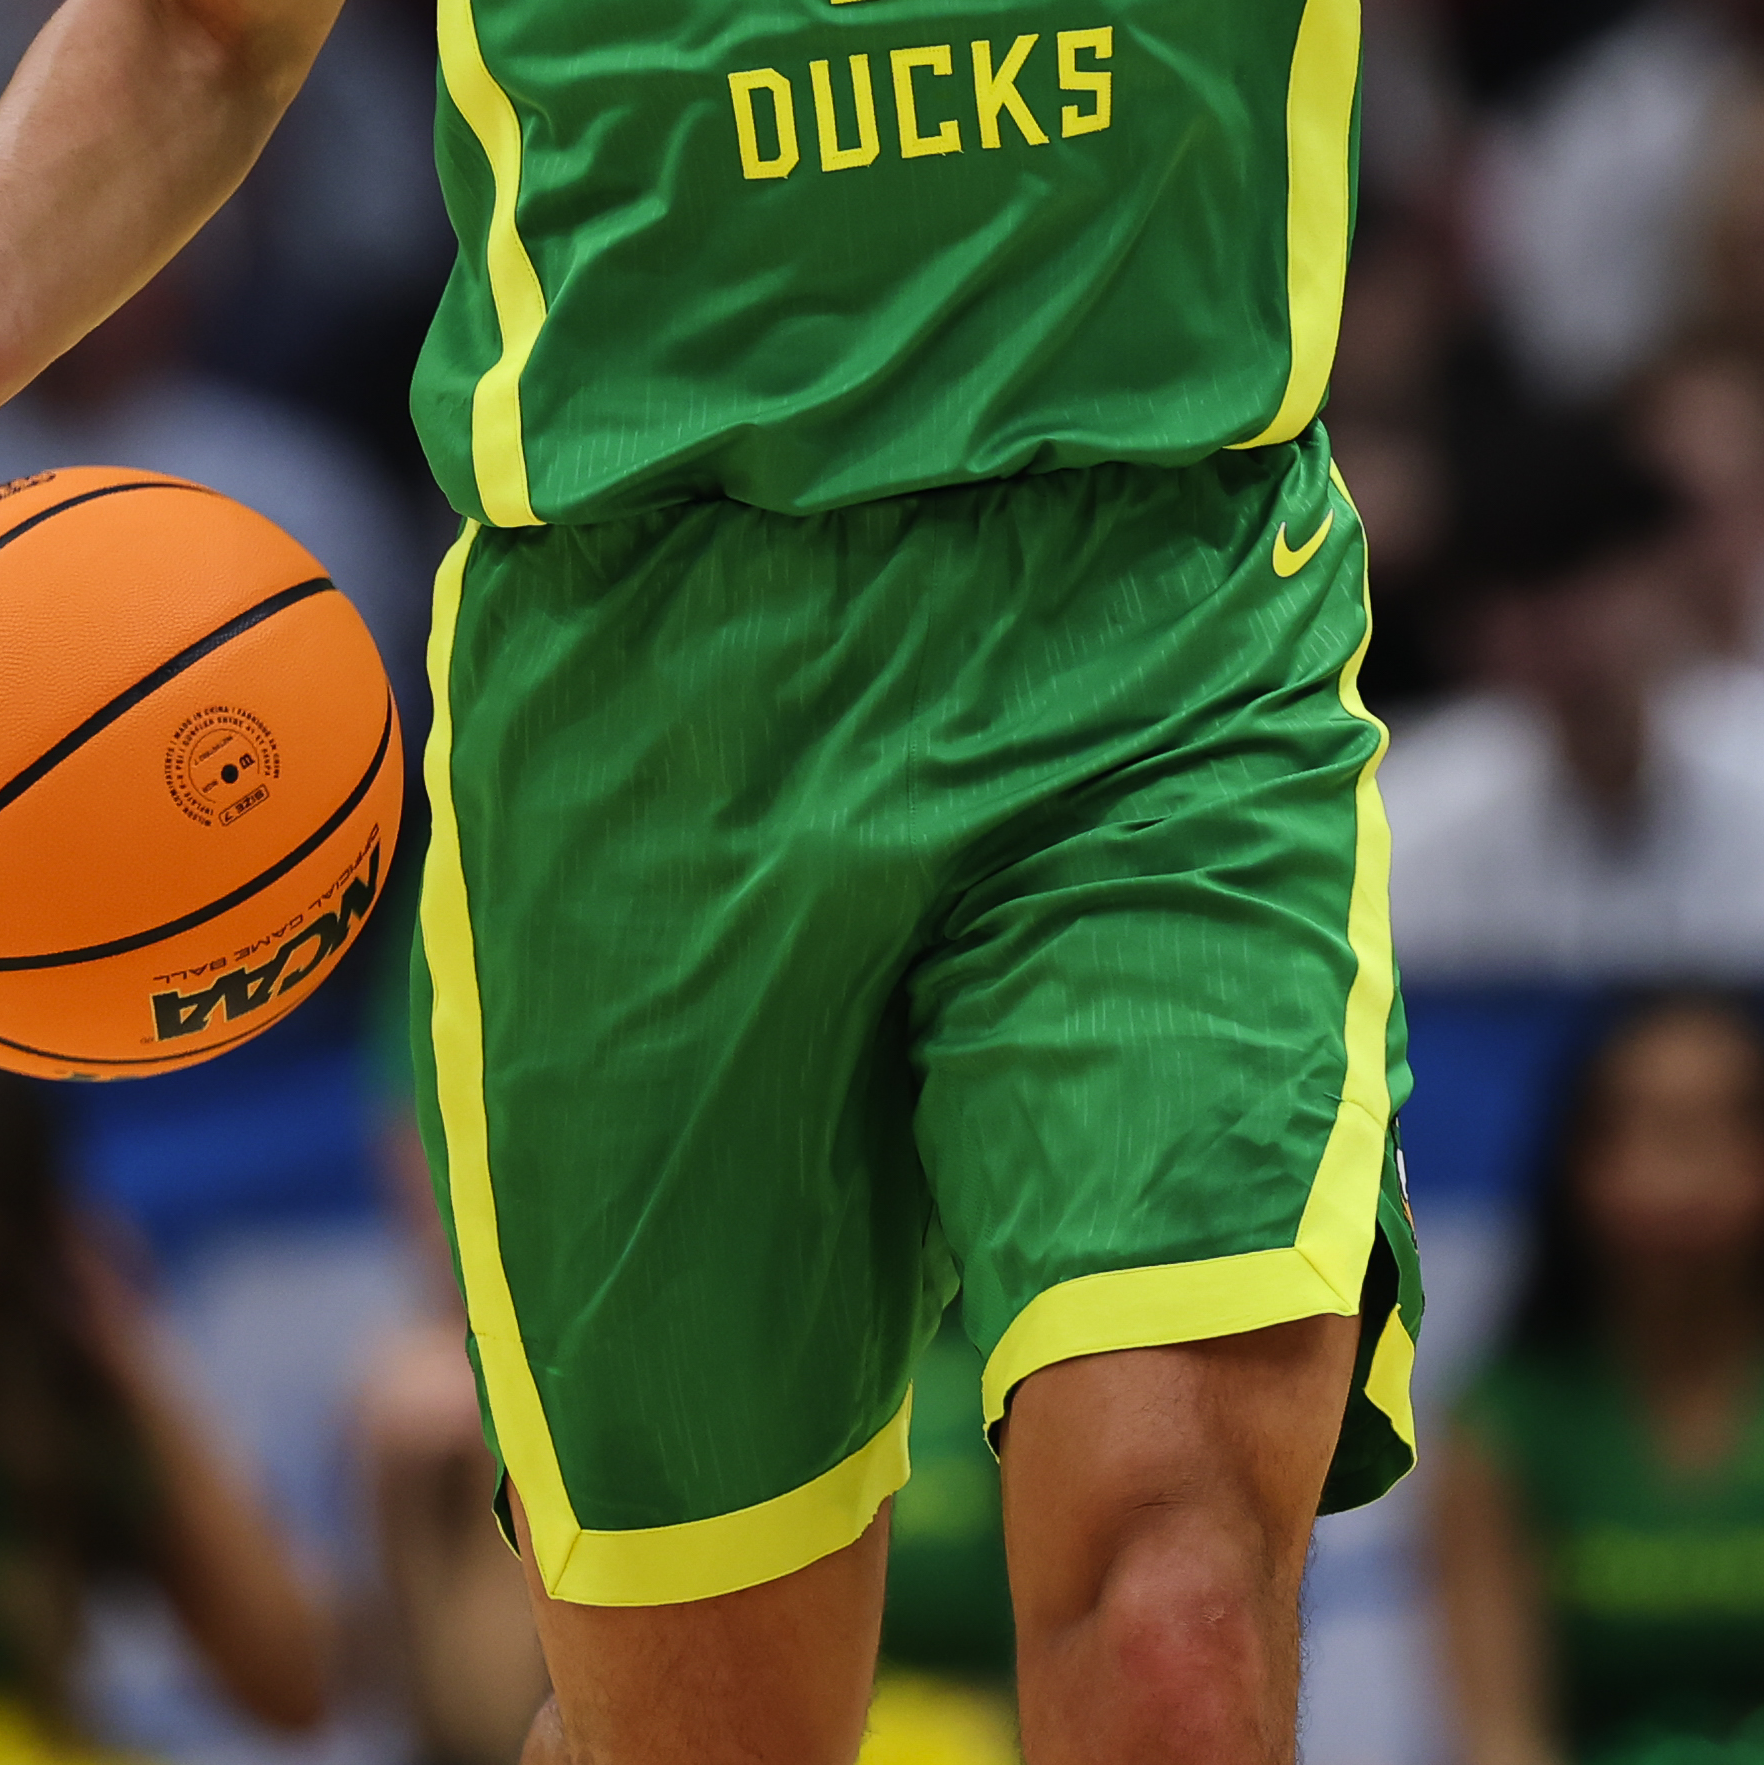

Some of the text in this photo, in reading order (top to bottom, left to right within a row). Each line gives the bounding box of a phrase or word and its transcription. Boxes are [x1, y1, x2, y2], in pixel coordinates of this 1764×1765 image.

[728, 26, 1113, 180] DUCKS
[174, 718, 192, 739] MADE
[224, 789, 264, 822] SIZE 7
[150, 837, 381, 1042] NCAA
[153, 823, 380, 984] OFFICIAL GAME BALL
